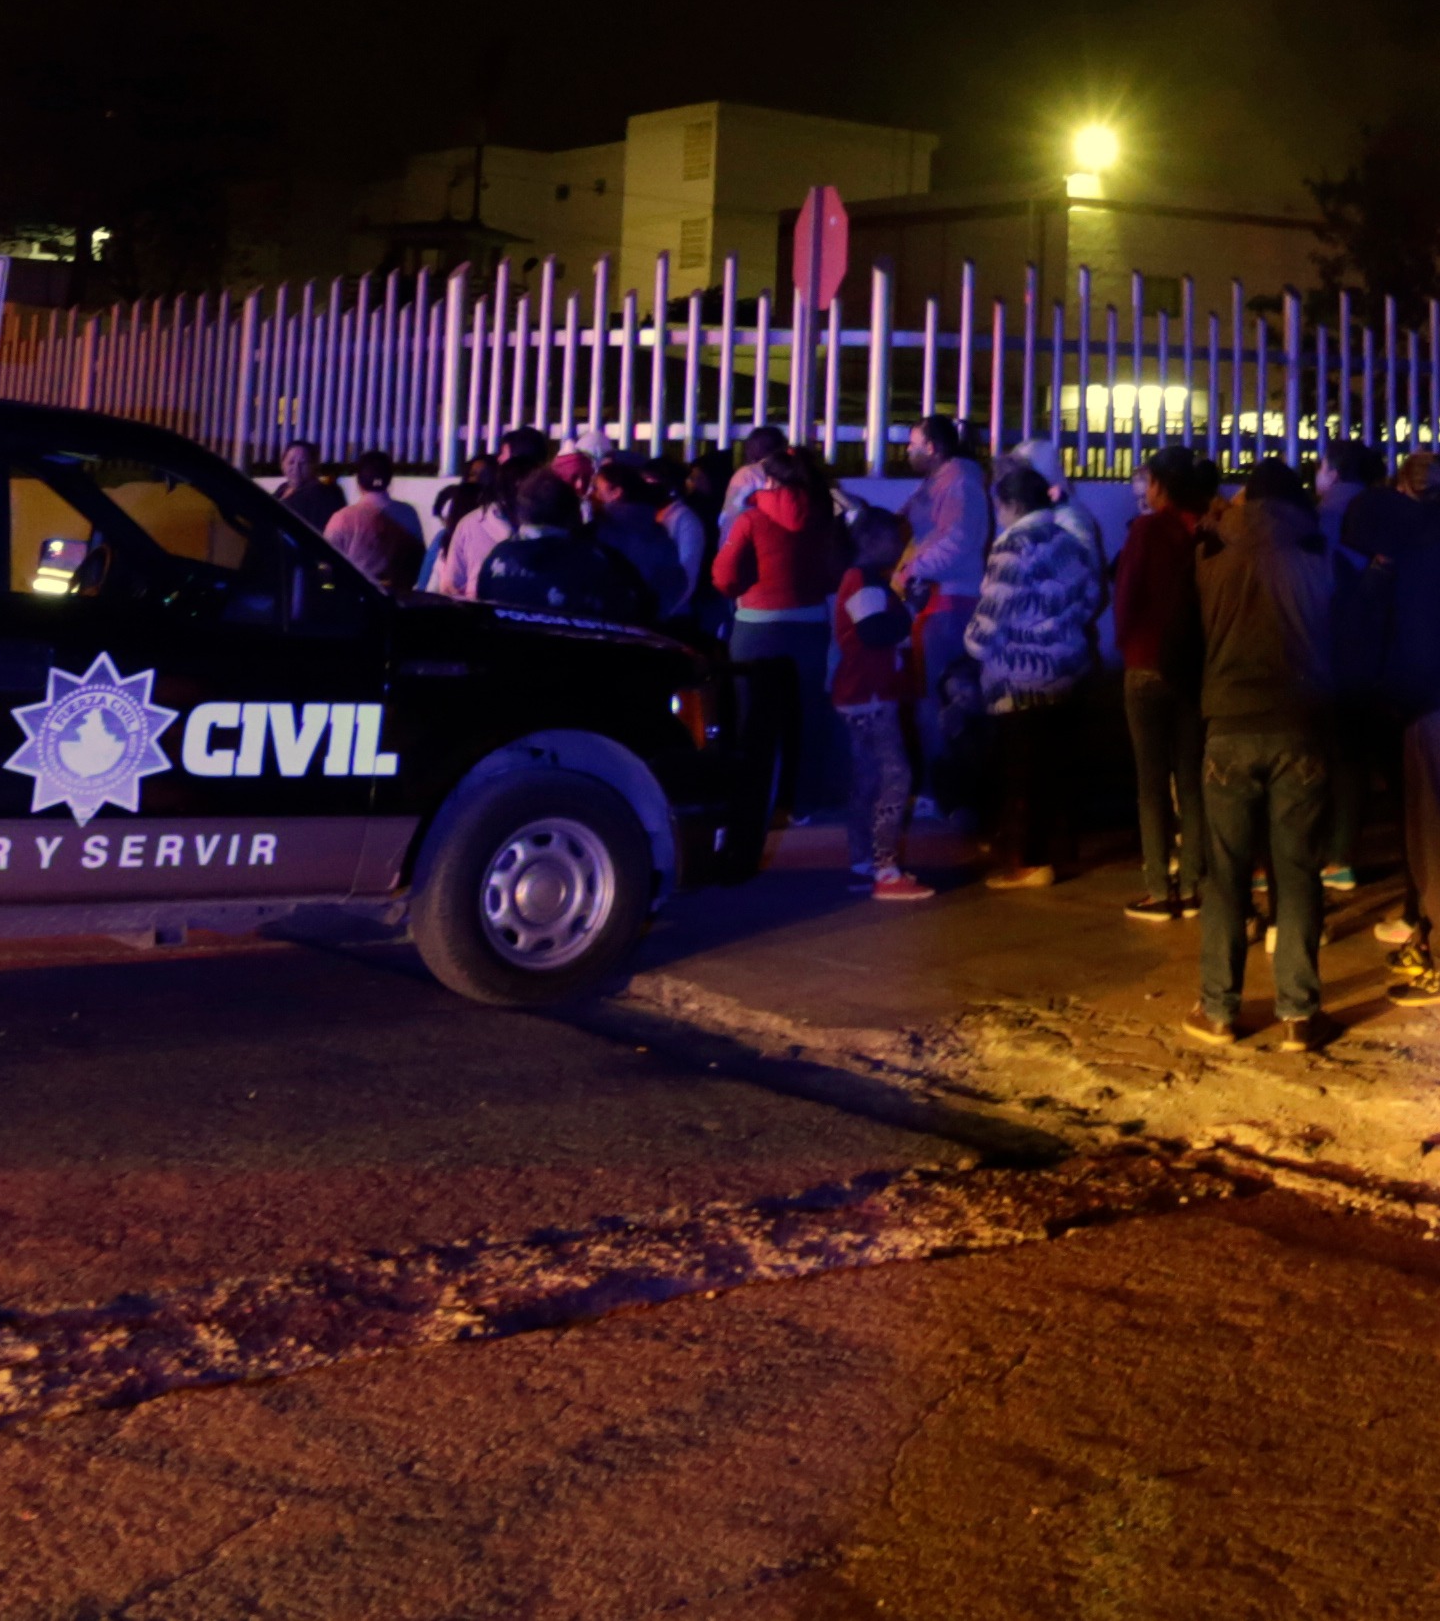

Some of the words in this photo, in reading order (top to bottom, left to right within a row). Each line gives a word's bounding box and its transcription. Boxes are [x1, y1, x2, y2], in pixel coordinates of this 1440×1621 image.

[55, 695, 106, 725] FUERZA
[111, 699, 135, 724] CIVIL
[183, 702, 398, 777] CIVIL
[35, 835, 67, 870] Y
[79, 833, 279, 870] SERVIR
